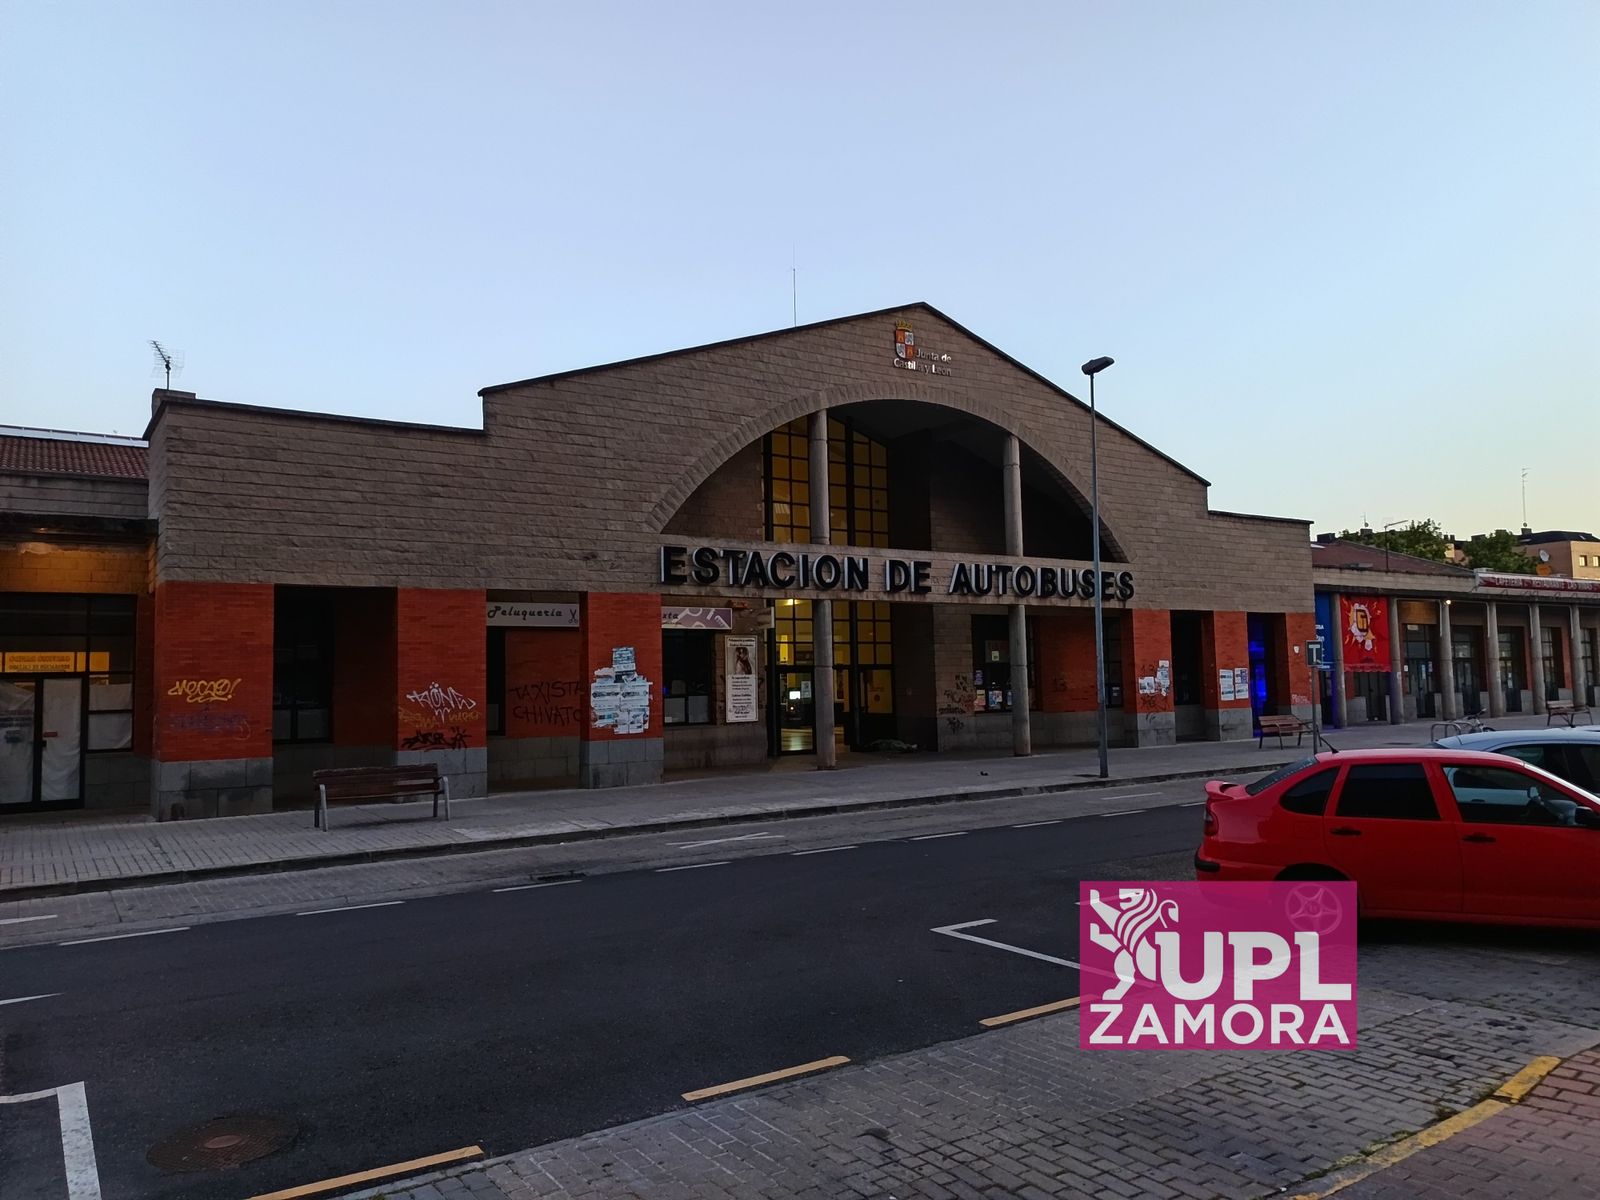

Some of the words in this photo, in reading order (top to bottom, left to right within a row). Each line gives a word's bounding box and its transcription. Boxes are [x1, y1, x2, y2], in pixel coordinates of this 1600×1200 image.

[941, 353, 952, 363] de
[661, 546, 869, 591] ESTACION
[885, 560, 932, 593] DE
[949, 563, 1135, 600] AUTOBUSES
